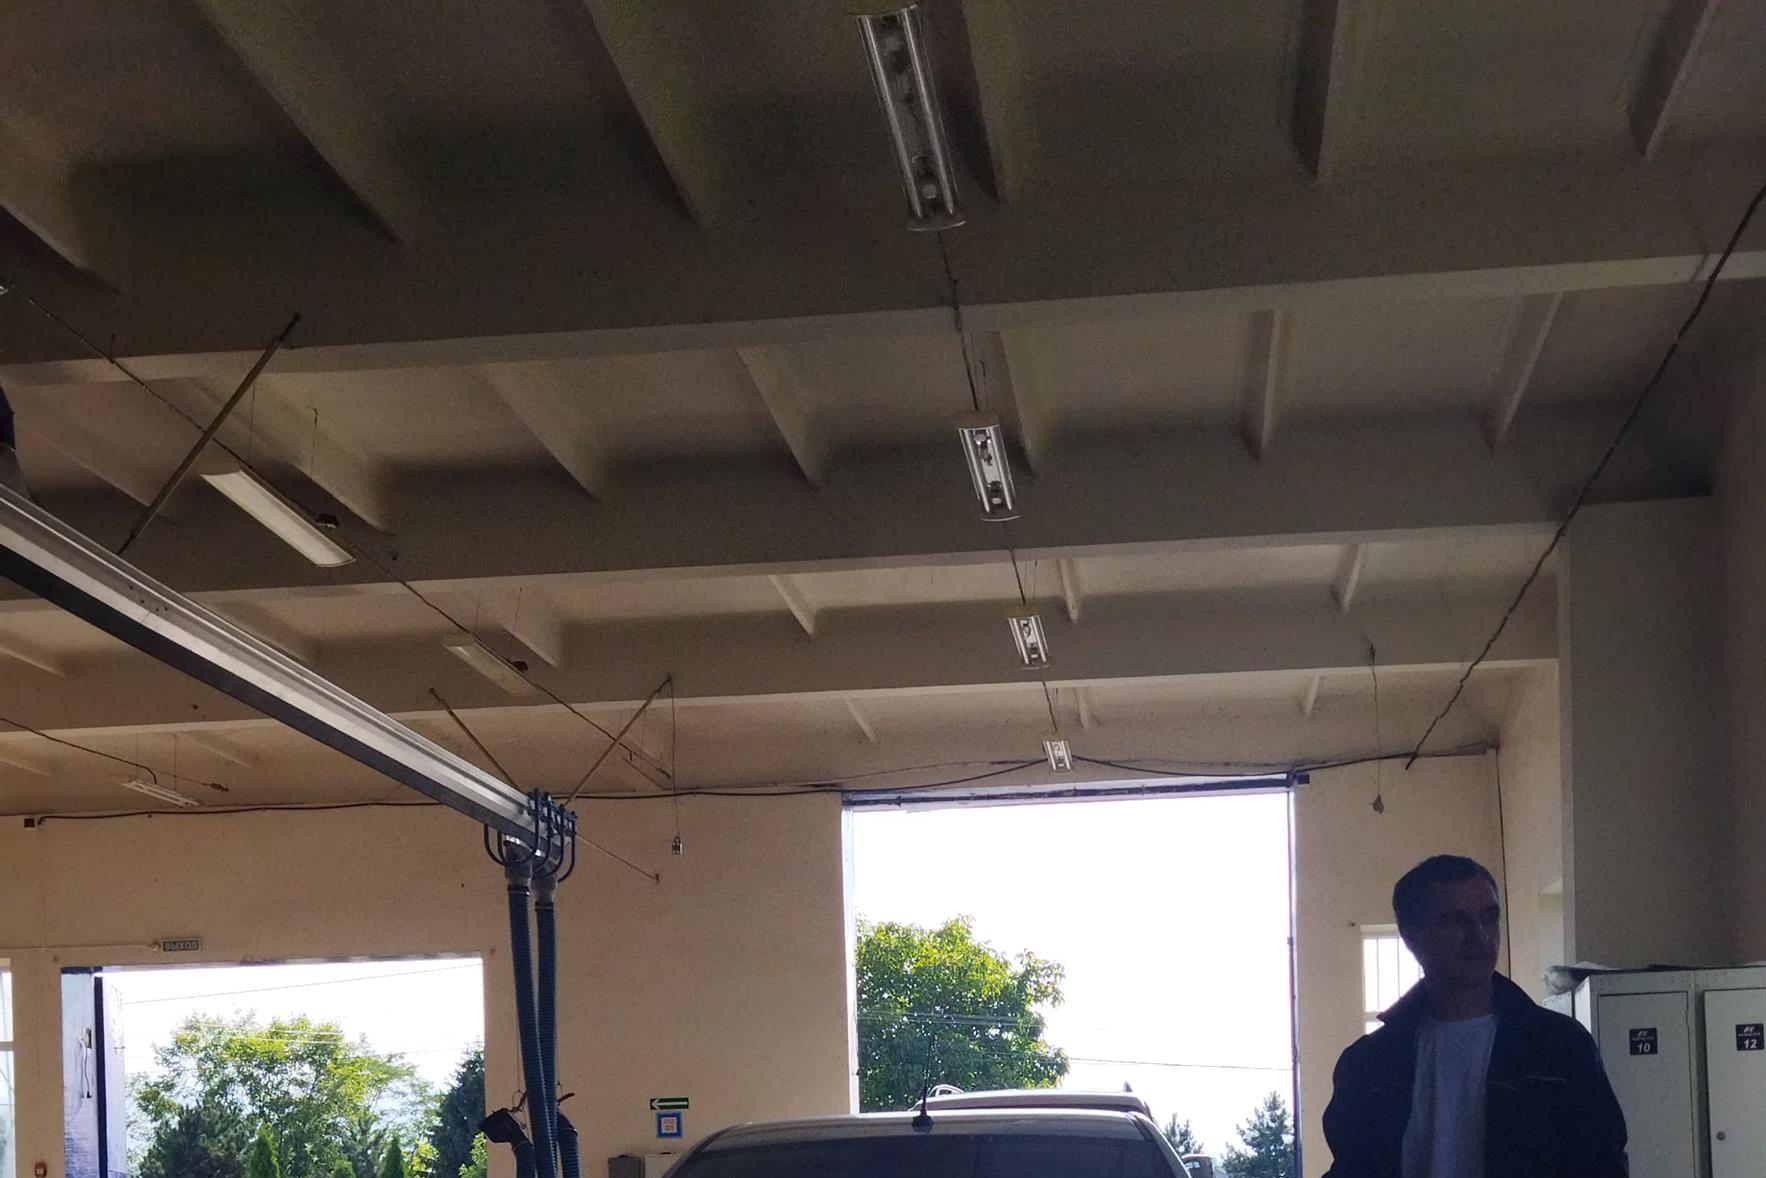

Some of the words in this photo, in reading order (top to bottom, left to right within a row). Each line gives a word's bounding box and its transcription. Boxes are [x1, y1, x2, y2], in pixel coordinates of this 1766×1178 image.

[164, 941, 198, 951] ВЫХОД
[1637, 1042, 1651, 1053] 10
[1744, 1038, 1758, 1049] 12
